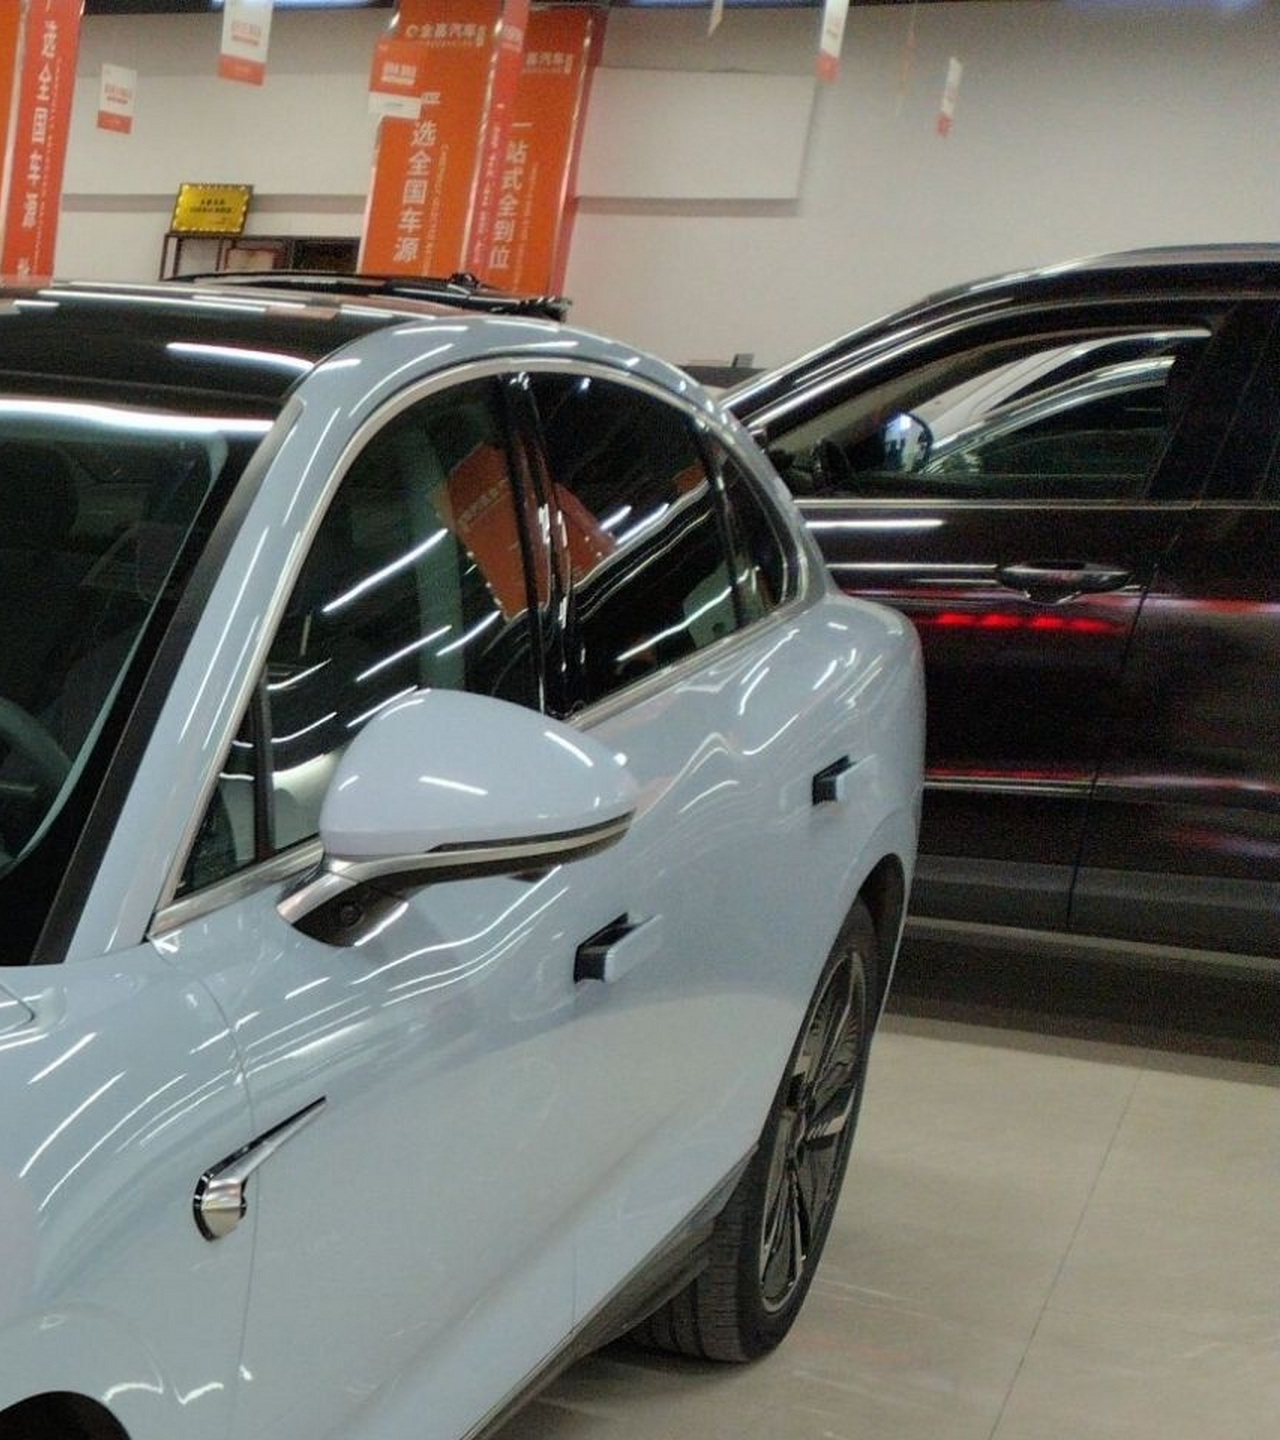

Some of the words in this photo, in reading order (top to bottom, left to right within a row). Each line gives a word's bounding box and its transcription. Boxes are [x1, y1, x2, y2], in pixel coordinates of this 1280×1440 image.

[22, 0, 58, 229] 选全国车源
[489, 122, 534, 270] 一站式全到位
